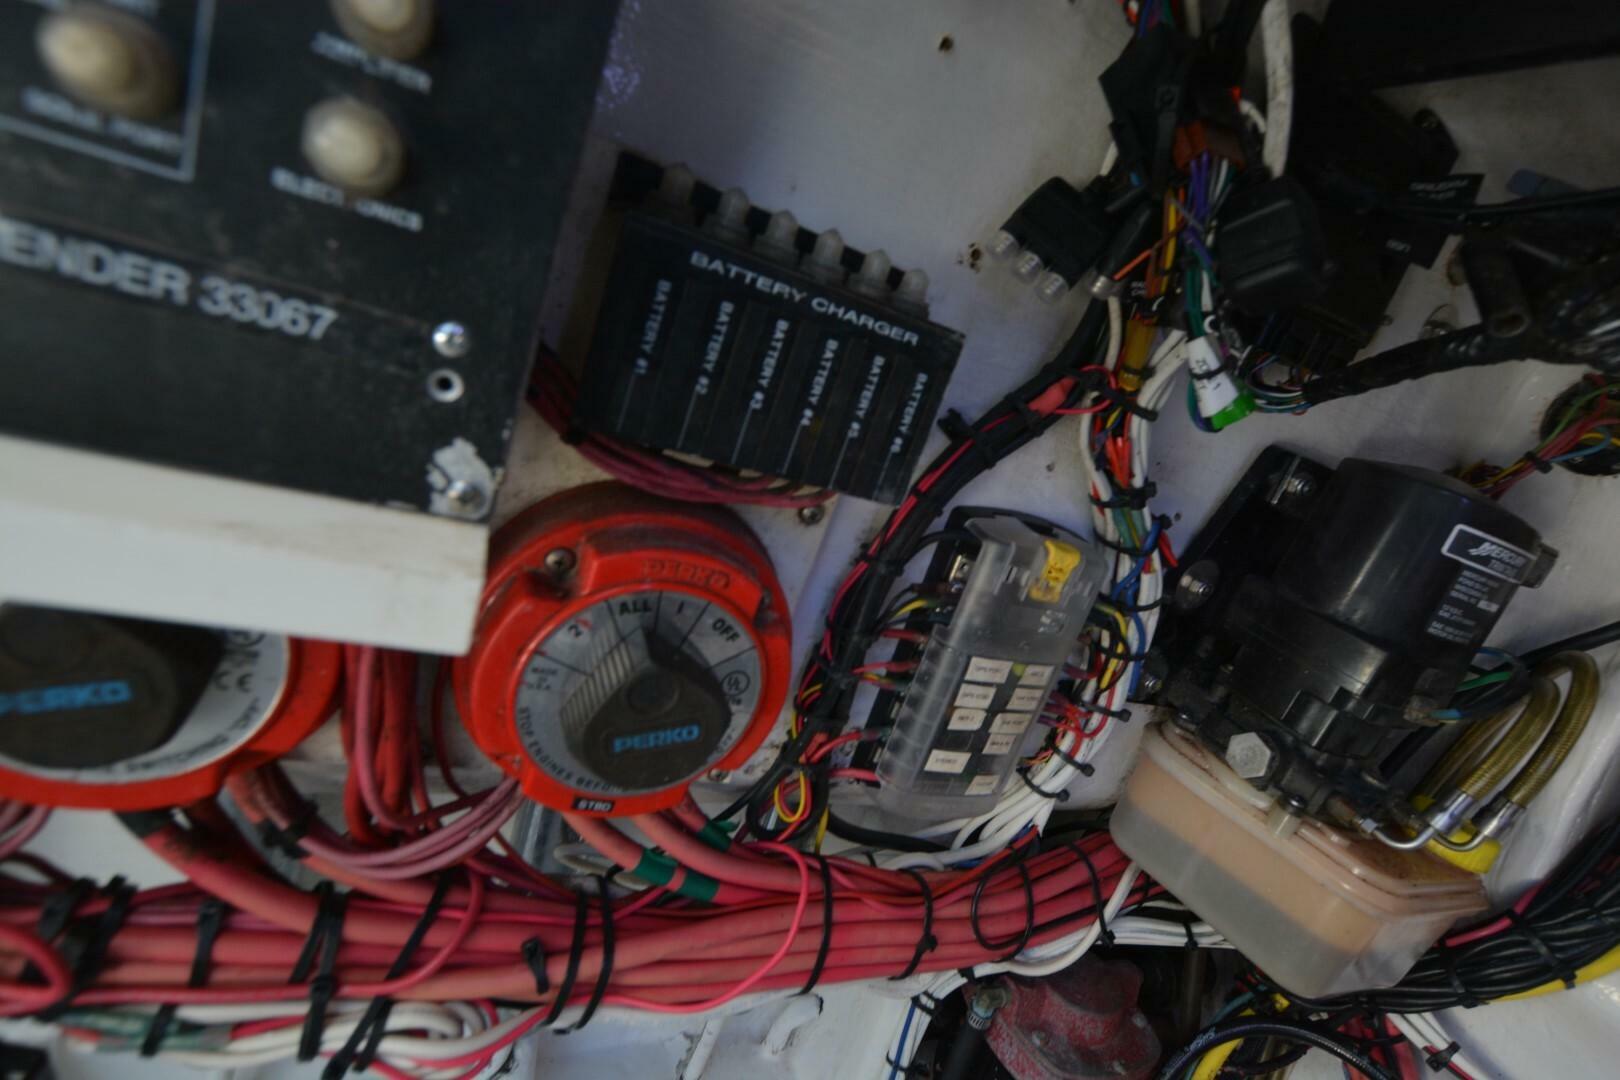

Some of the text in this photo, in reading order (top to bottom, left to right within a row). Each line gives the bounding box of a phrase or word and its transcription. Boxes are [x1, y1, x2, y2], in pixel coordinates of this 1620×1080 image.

[271, 166, 423, 233] ELECTONICS
[199, 275, 339, 342] 33067
[639, 279, 673, 355] BATTERY
[689, 250, 920, 347] BATTERY CHARGER
[703, 301, 735, 374] BATTERY
[758, 318, 790, 390] BATTERY
[809, 338, 840, 407] BATTERY
[855, 355, 886, 421] BATTERY
[897, 372, 929, 435] BATTERY
[1468, 541, 1528, 568] MERCUR
[619, 599, 653, 617] ALL
[711, 618, 741, 643] OFF
[613, 725, 700, 753] PERKO
